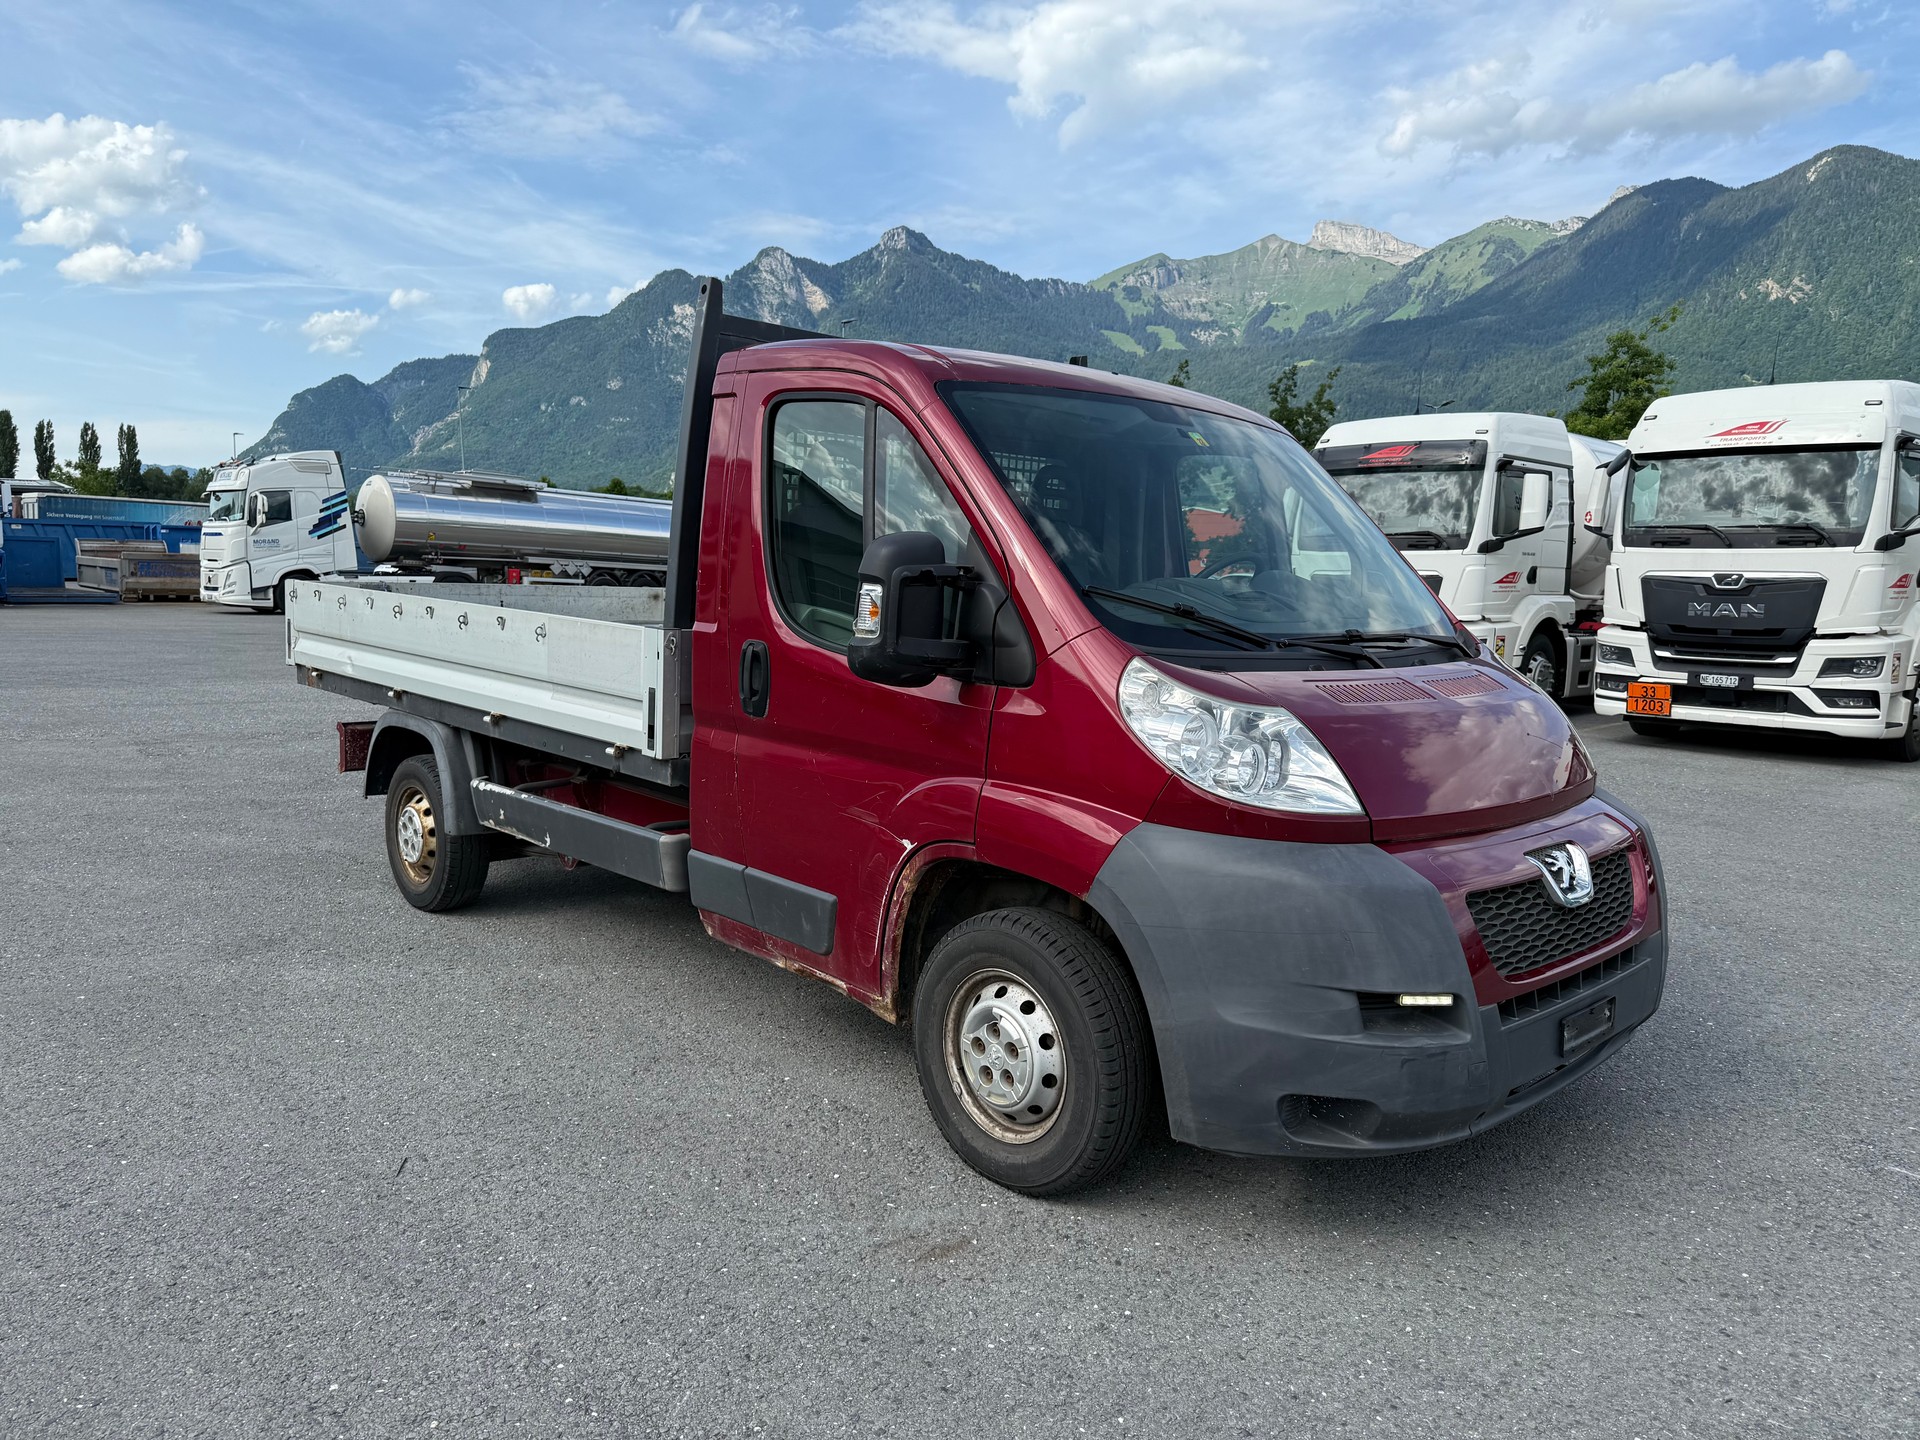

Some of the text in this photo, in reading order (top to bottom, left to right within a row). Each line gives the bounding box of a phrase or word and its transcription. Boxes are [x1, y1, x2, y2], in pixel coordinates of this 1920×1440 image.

[1687, 602, 1765, 618] MAN
[1640, 685, 1656, 698] 33
[1634, 698, 1664, 713] 1203
